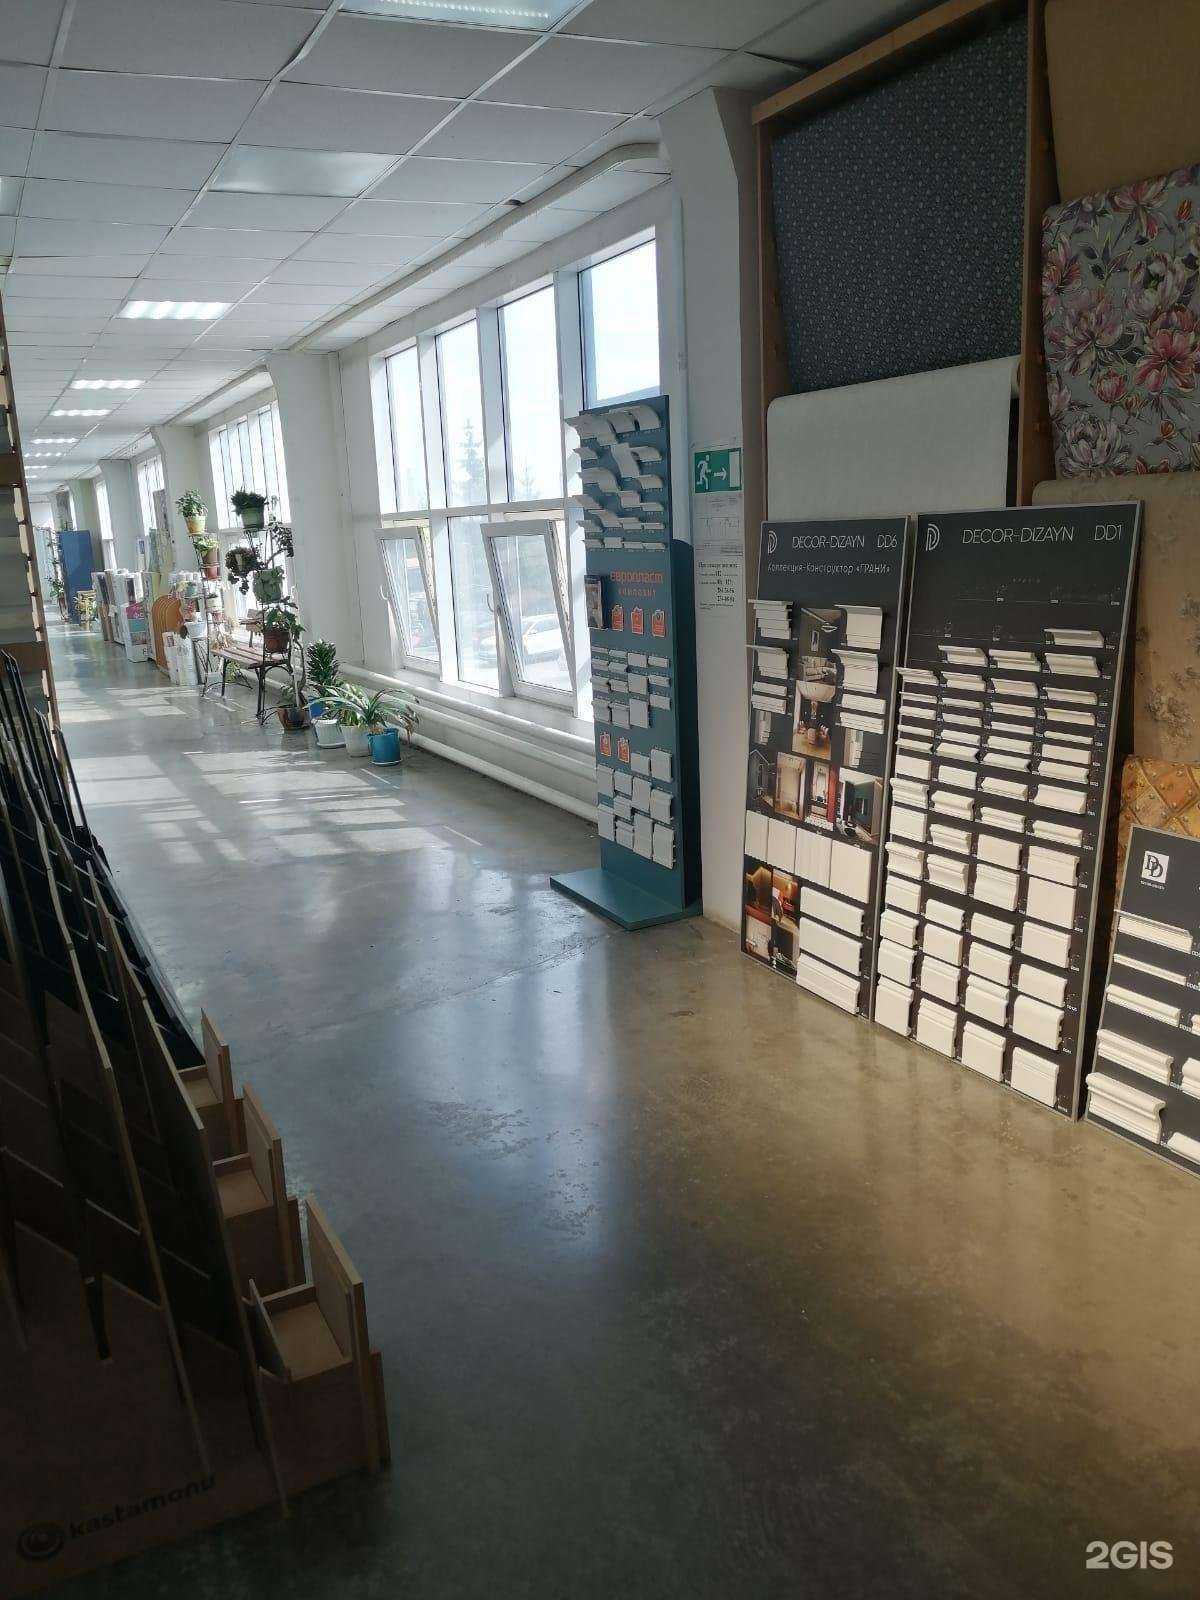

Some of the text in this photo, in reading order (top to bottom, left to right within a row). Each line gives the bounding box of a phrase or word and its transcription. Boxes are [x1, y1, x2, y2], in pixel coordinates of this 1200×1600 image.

[792, 534, 898, 549] DECOR-DIZAYN DD6
[962, 524, 1123, 544] DECOR-DIZAYN DD1
[70, 1474, 216, 1539] kastamonu
